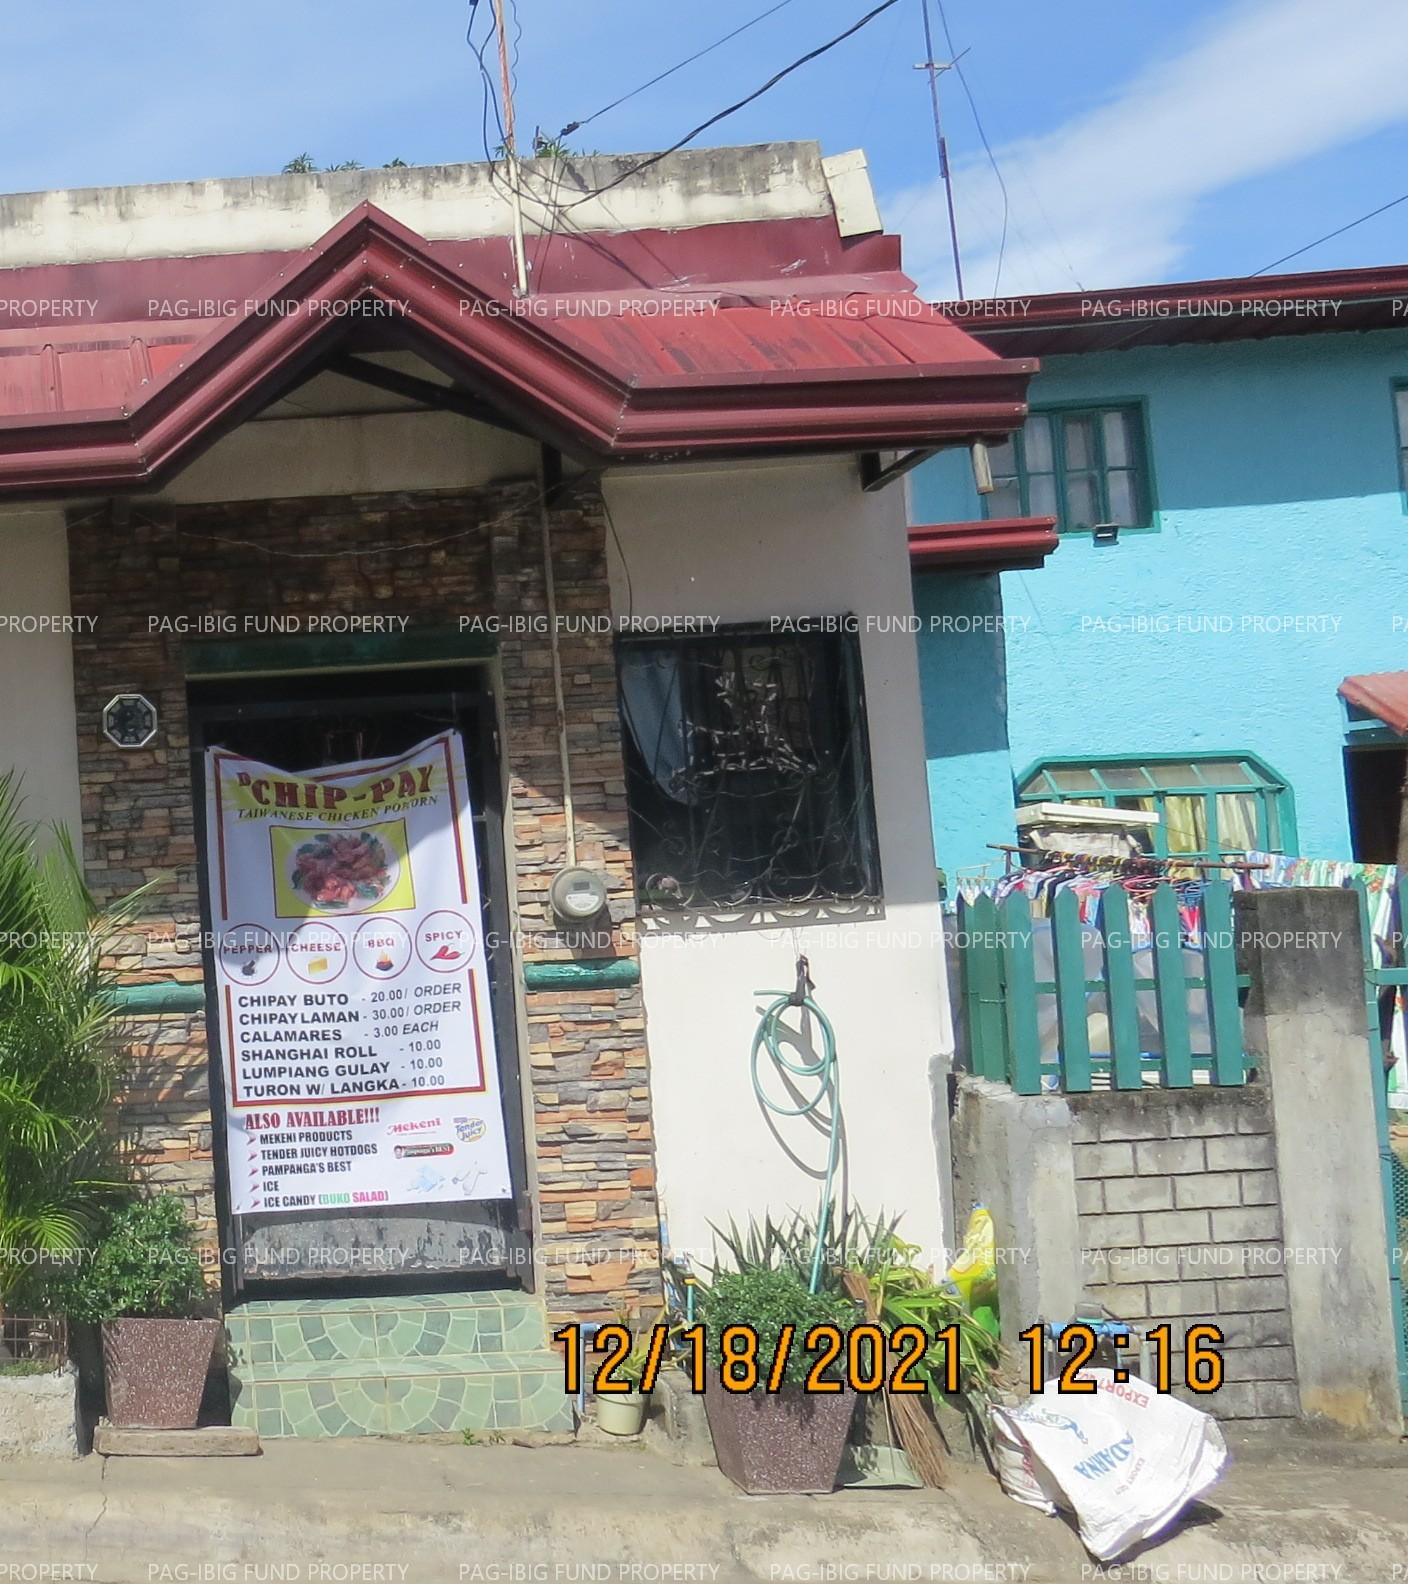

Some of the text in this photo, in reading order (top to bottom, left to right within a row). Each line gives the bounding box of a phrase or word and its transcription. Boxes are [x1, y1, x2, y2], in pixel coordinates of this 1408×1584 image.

[238, 808, 314, 821] TAIWANESE
[318, 809, 378, 822] CHICKEN
[425, 930, 462, 942] SPICY
[224, 944, 272, 954] PEPPER
[292, 943, 341, 952] CHEESE
[238, 994, 297, 1008] CHIPAY
[303, 994, 349, 1006] BUTO
[414, 983, 462, 998] ORDER
[239, 1012, 299, 1025] CHIPAY
[301, 1011, 359, 1024] LAMAN
[414, 1001, 461, 1016] ORDER
[240, 1021, 439, 1043] CALAMARES 3.00 EACH
[241, 1039, 441, 1062] SHANGHAI ROLL 10.00
[242, 1057, 442, 1080] LUMPIANG GULAY 10.00
[243, 1075, 444, 1098] TURON W/ LANGKA 10.00
[245, 1107, 380, 1130] ALSO AVAILABLE!!!
[260, 1130, 352, 1145] MEKENI PRODUCTS
[261, 1144, 378, 1160] TENDER JUICY HOTDOGS
[262, 1161, 352, 1176] PAMPANGA'S BEST
[263, 1181, 279, 1192] ICE
[264, 1197, 280, 1208] ICE
[282, 1195, 316, 1207] CANDY
